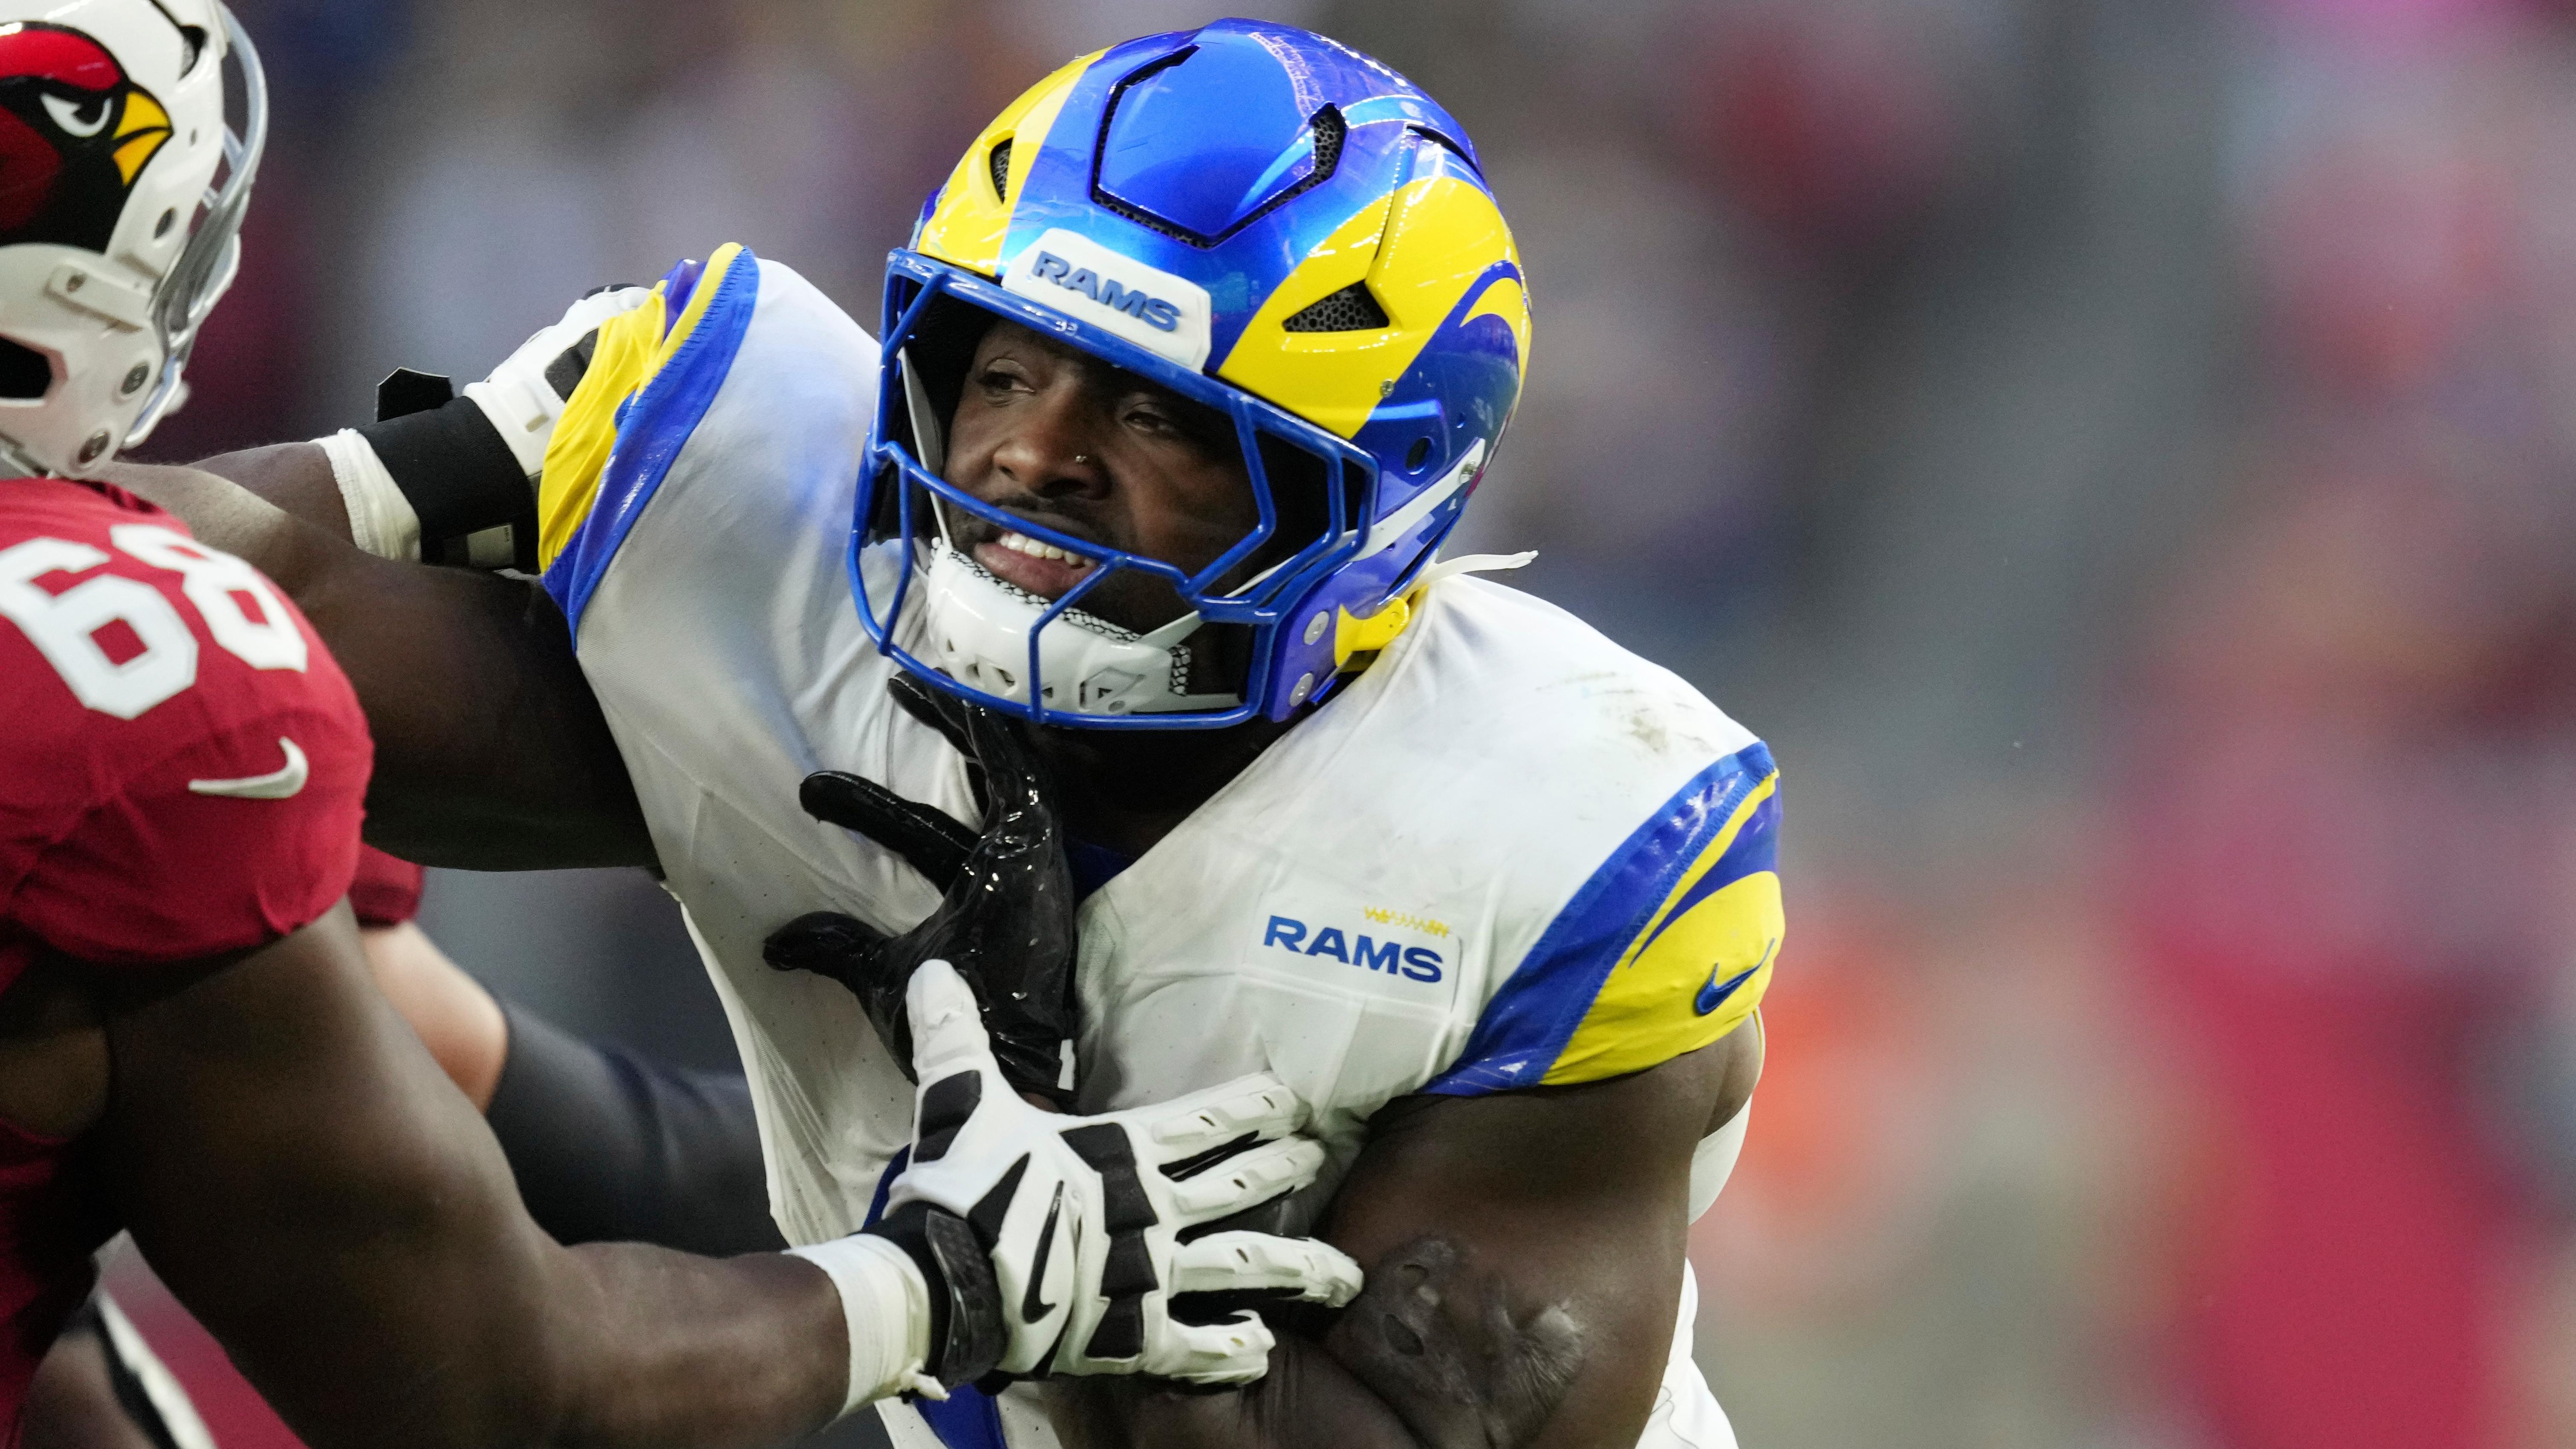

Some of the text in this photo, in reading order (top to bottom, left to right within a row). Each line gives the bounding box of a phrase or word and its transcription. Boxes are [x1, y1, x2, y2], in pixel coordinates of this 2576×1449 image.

[1031, 250, 1182, 332] RAMS
[0, 523, 308, 720] 68
[1264, 915, 1443, 983] RAMS
